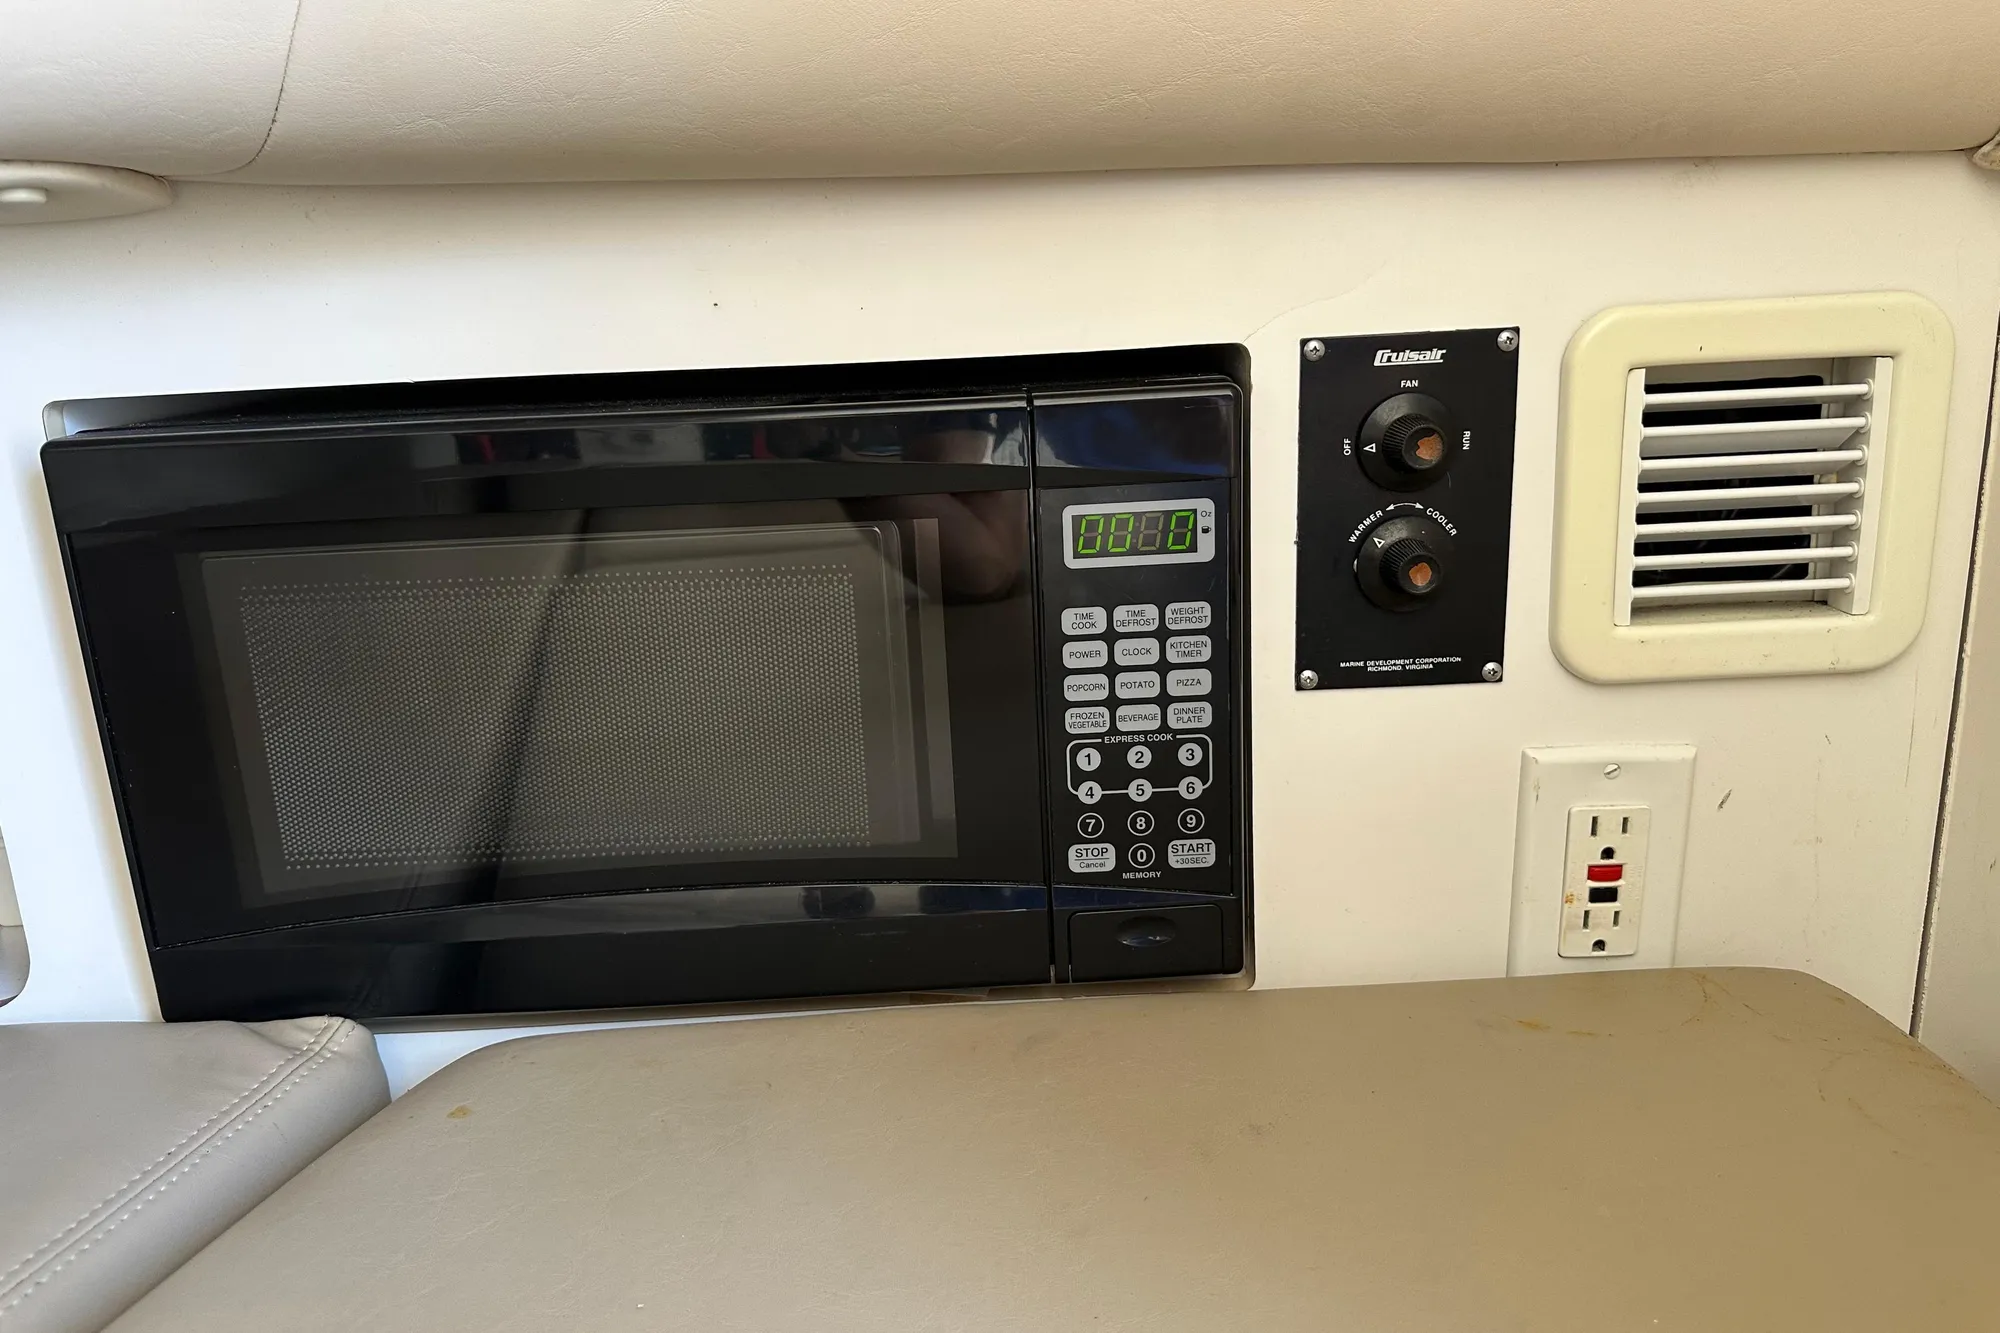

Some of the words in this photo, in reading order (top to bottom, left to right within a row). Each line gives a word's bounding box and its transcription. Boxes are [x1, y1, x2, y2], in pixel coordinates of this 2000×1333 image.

[1373, 348, 1447, 366] Cruisair
[1400, 379, 1419, 388] FAN
[1462, 430, 1471, 450] RUN
[1343, 438, 1351, 456] OFF
[1348, 509, 1384, 544] WARMER
[1426, 507, 1457, 537] COOLER
[1125, 610, 1146, 618] TIME
[1170, 606, 1205, 616] WEIGHT
[1074, 613, 1094, 621] TIME
[1167, 615, 1209, 625] DEFROST
[1071, 621, 1097, 630] COOK
[1115, 618, 1157, 628] DEFROST
[1170, 641, 1208, 650] KITCHEN
[1069, 650, 1101, 659] POWER
[1121, 647, 1152, 656] CLOCK
[1175, 650, 1202, 658] TIMER
[1366, 658, 1413, 667] DEVELOPMENT
[1415, 656, 1461, 664] CORPORATION
[1067, 683, 1106, 692] POPCORN
[1120, 680, 1155, 690] POTATO
[1176, 678, 1202, 687] PIZZA
[1070, 712, 1105, 720] FROZEN
[1173, 707, 1206, 715] DINNER
[1118, 713, 1159, 722] BEVERAGE
[1176, 715, 1203, 724] PLATE
[1068, 720, 1107, 729] VEGETABLE
[1104, 735, 1145, 744] EXPRESS
[1147, 733, 1173, 742] COOK
[1084, 753, 1092, 766] 1
[1134, 750, 1145, 764] 2
[1185, 748, 1195, 761] 3
[1085, 786, 1095, 799] 4
[1135, 784, 1145, 797] 5
[1186, 781, 1196, 794] 6
[1085, 819, 1096, 832] 7
[1135, 817, 1146, 830] 8
[1186, 814, 1197, 828] 9
[1075, 847, 1109, 859] STOP
[1170, 842, 1212, 854] START
[1136, 849, 1147, 863] 0
[1079, 861, 1106, 869] Cancel
[1122, 871, 1162, 879] MEMORY
